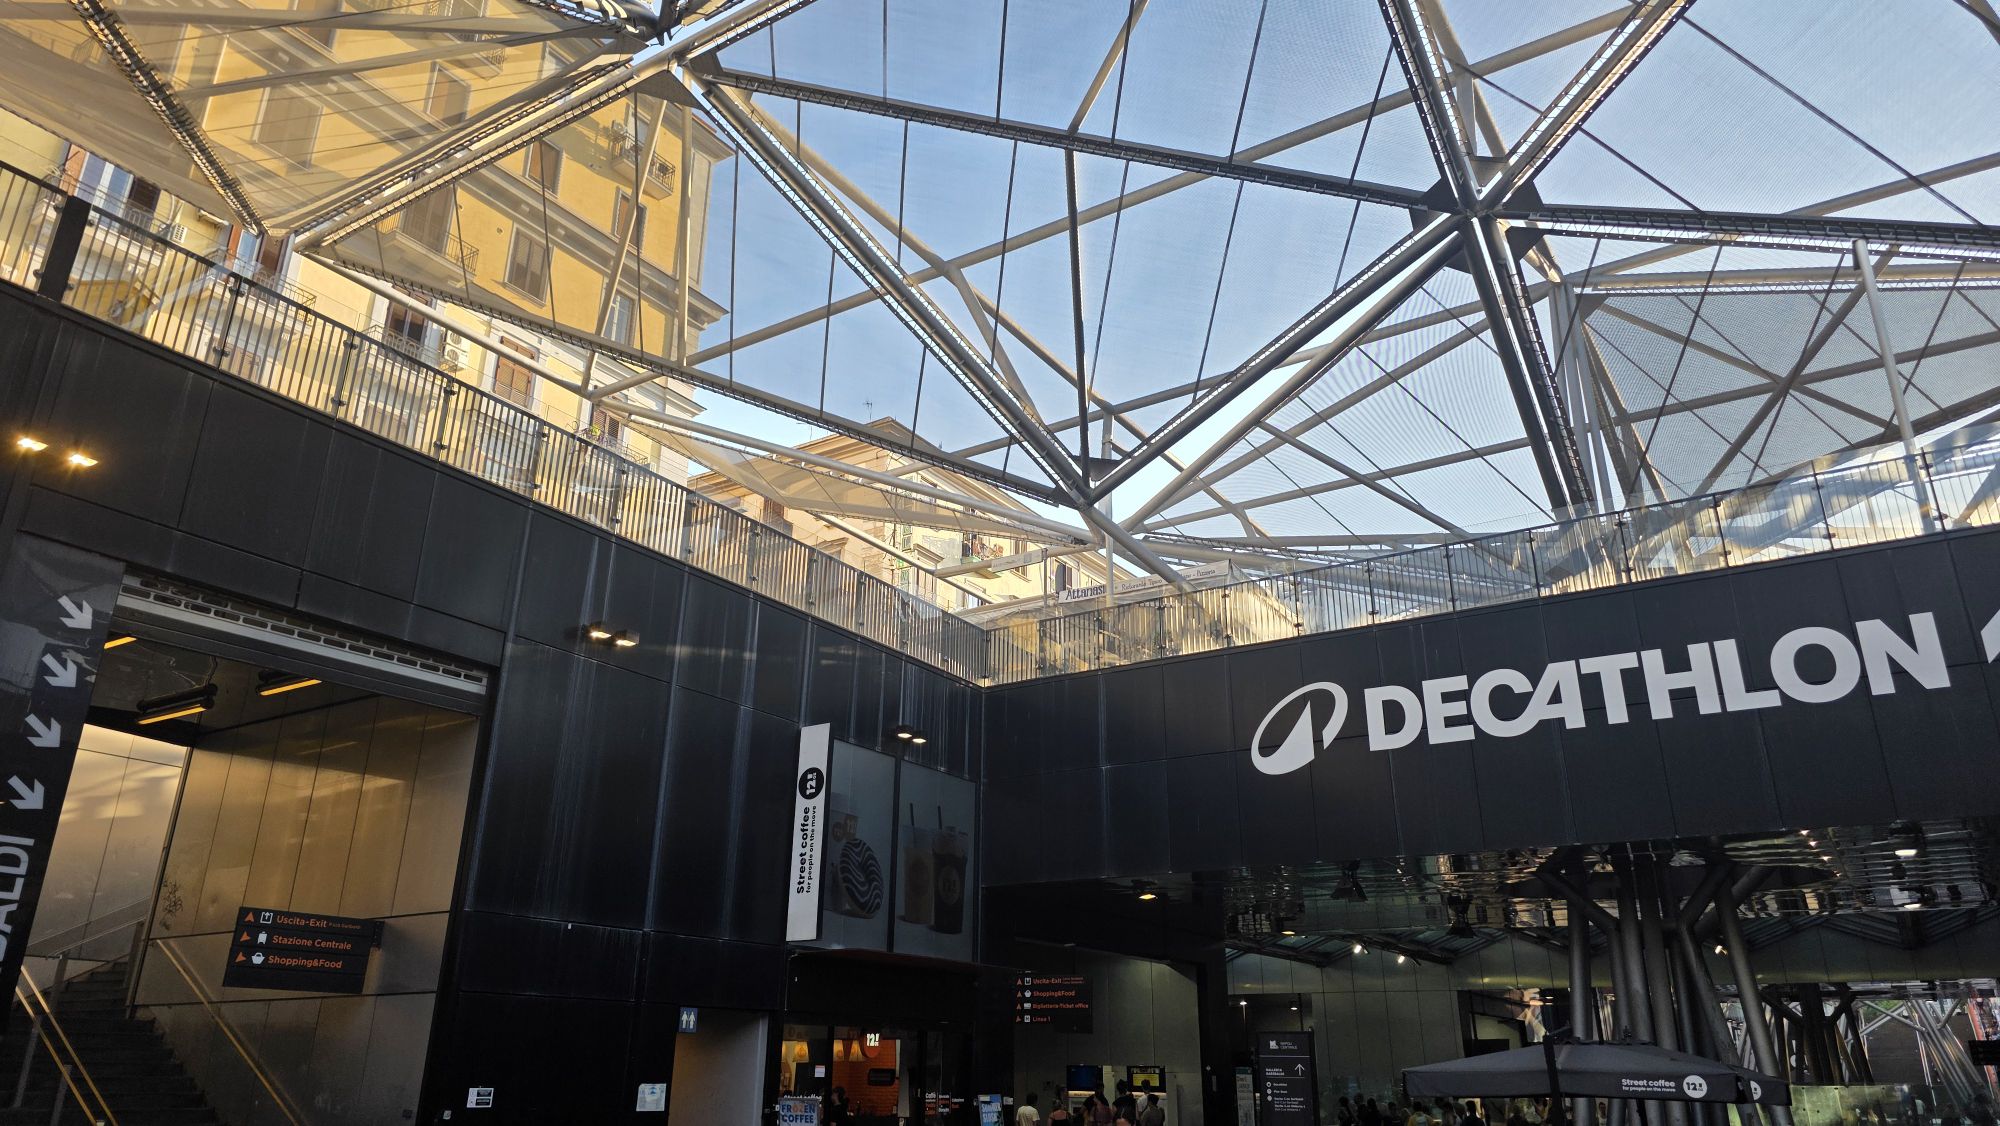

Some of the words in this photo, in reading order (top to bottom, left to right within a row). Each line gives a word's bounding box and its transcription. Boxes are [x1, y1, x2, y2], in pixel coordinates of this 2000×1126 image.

[1065, 584, 1106, 601] Attanasi
[1364, 612, 1950, 752] DECATHLON
[800, 806, 810, 849] coffee
[809, 842, 814, 853] on
[796, 851, 807, 894] Street
[276, 914, 328, 929] Uscita-Exit
[272, 935, 313, 947] Stazione
[314, 938, 352, 950] Centrale
[267, 955, 343, 969] Shopping&Food
[1621, 1078, 1648, 1086] Street
[1648, 1079, 1676, 1087] coffee
[781, 1103, 816, 1113] FROZEN
[781, 1114, 815, 1124] COFFEE
